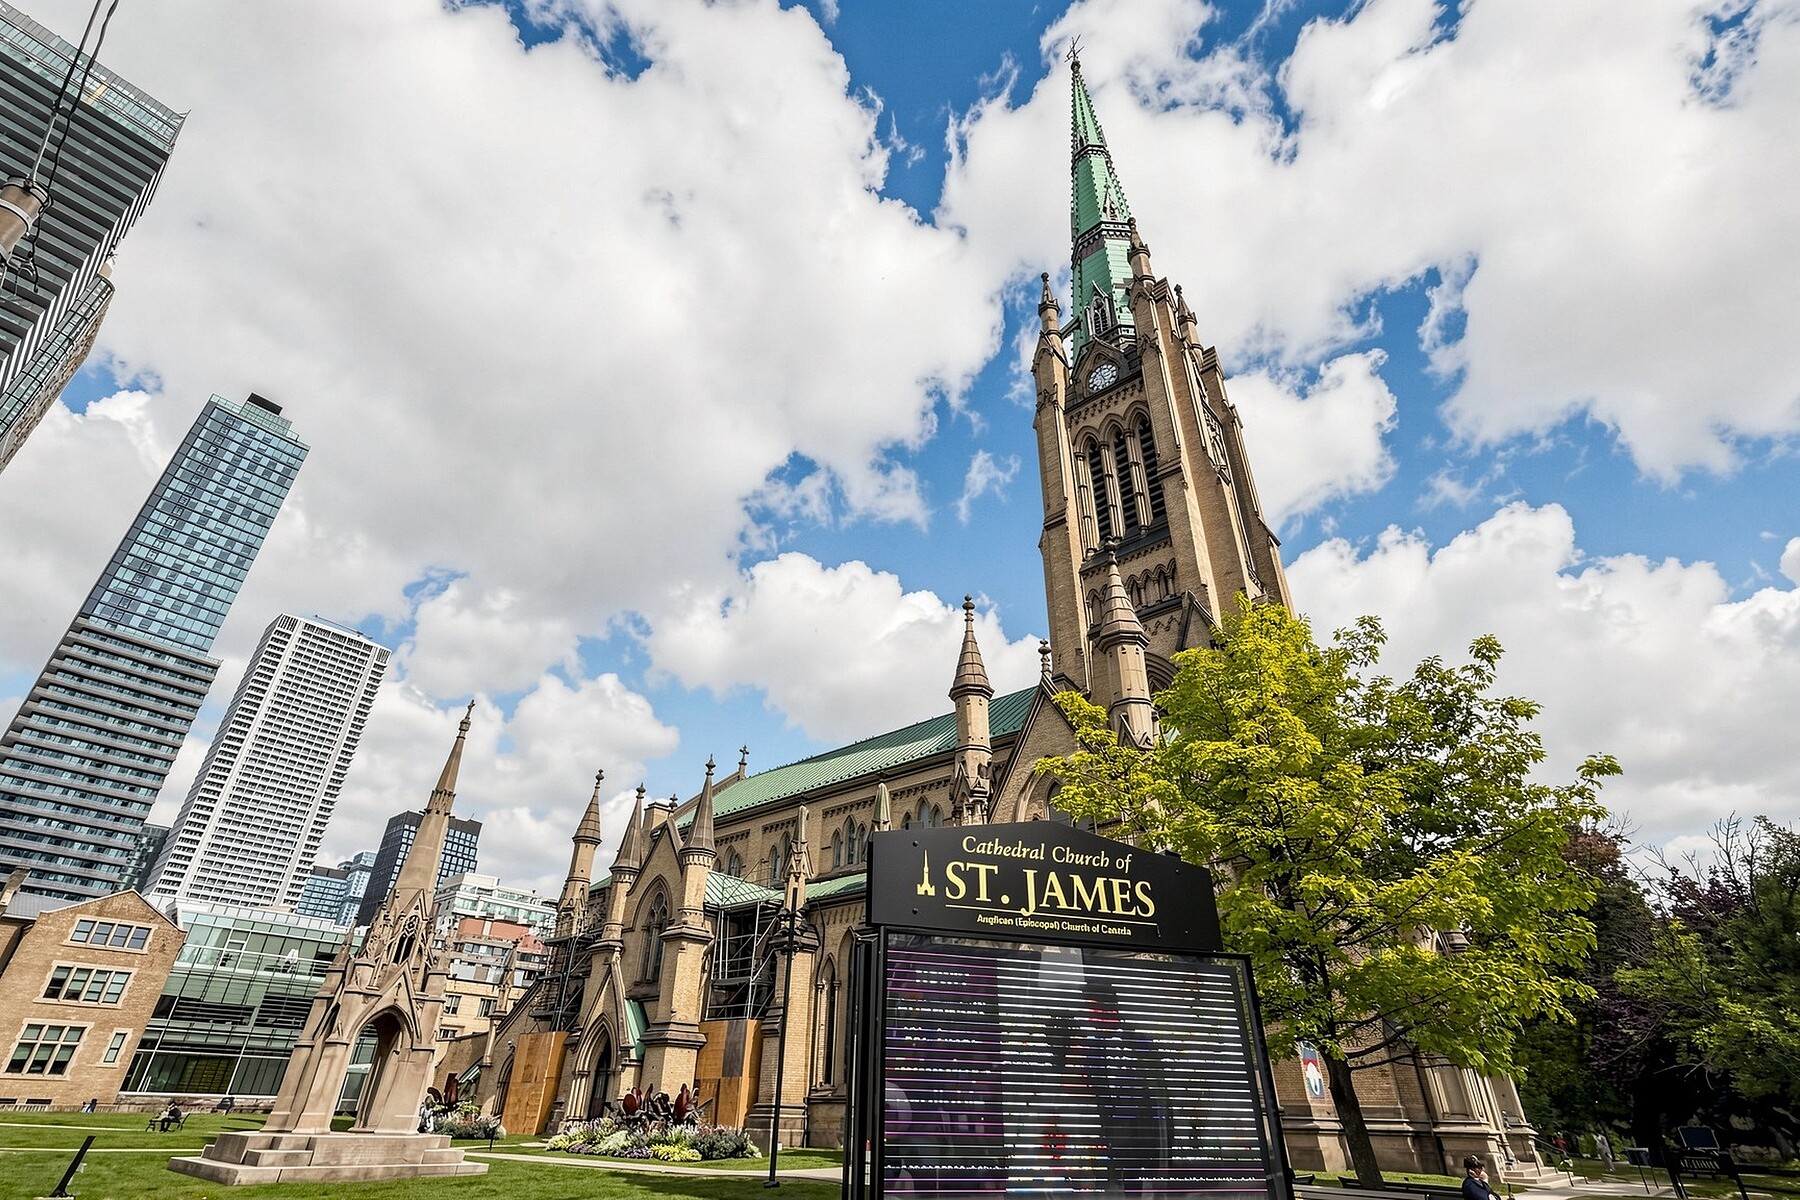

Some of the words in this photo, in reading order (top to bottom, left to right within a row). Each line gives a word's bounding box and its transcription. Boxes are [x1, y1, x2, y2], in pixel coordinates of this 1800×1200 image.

[962, 836, 1045, 860] Cathedral
[1052, 846, 1110, 867] Church
[1116, 853, 1132, 874] of
[945, 861, 1010, 905] ST.
[1020, 868, 1156, 918] JAMES
[976, 914, 1014, 926] Anglican
[1061, 921, 1091, 933] Church
[1091, 923, 1100, 933] of
